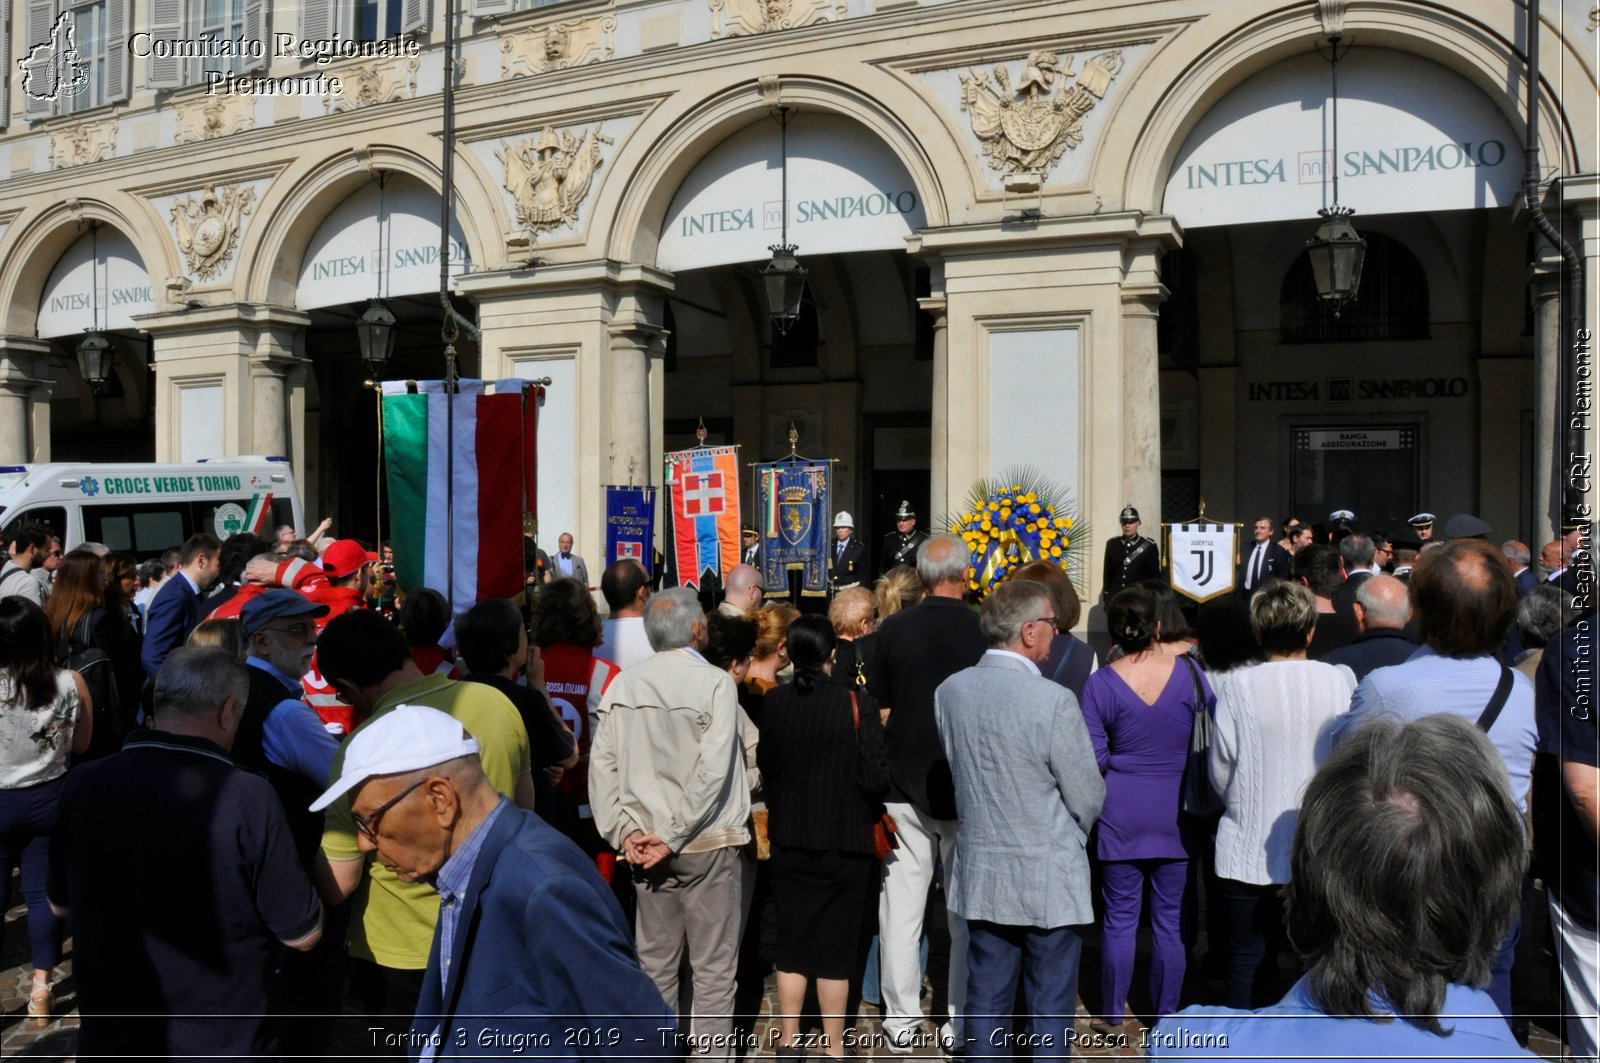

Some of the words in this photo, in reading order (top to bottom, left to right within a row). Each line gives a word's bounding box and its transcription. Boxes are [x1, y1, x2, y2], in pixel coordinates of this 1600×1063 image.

[1186, 158, 1287, 190] INTESA
[1343, 140, 1506, 177] SANPAOLO
[682, 208, 754, 237] INTESA
[796, 191, 917, 224] SANPAOLO
[313, 255, 365, 281] INTESA
[50, 293, 90, 313] INTESA
[1248, 381, 1319, 400] INTESA
[1358, 378, 1469, 399] SANPAOLO
[1320, 440, 1387, 448] ASSICURAZIONE
[104, 477, 151, 494] CROCE
[153, 476, 195, 493] VERDE
[195, 475, 241, 492] TORINO
[623, 526, 643, 536] TORINO
[545, 681, 564, 693] ROSSA
